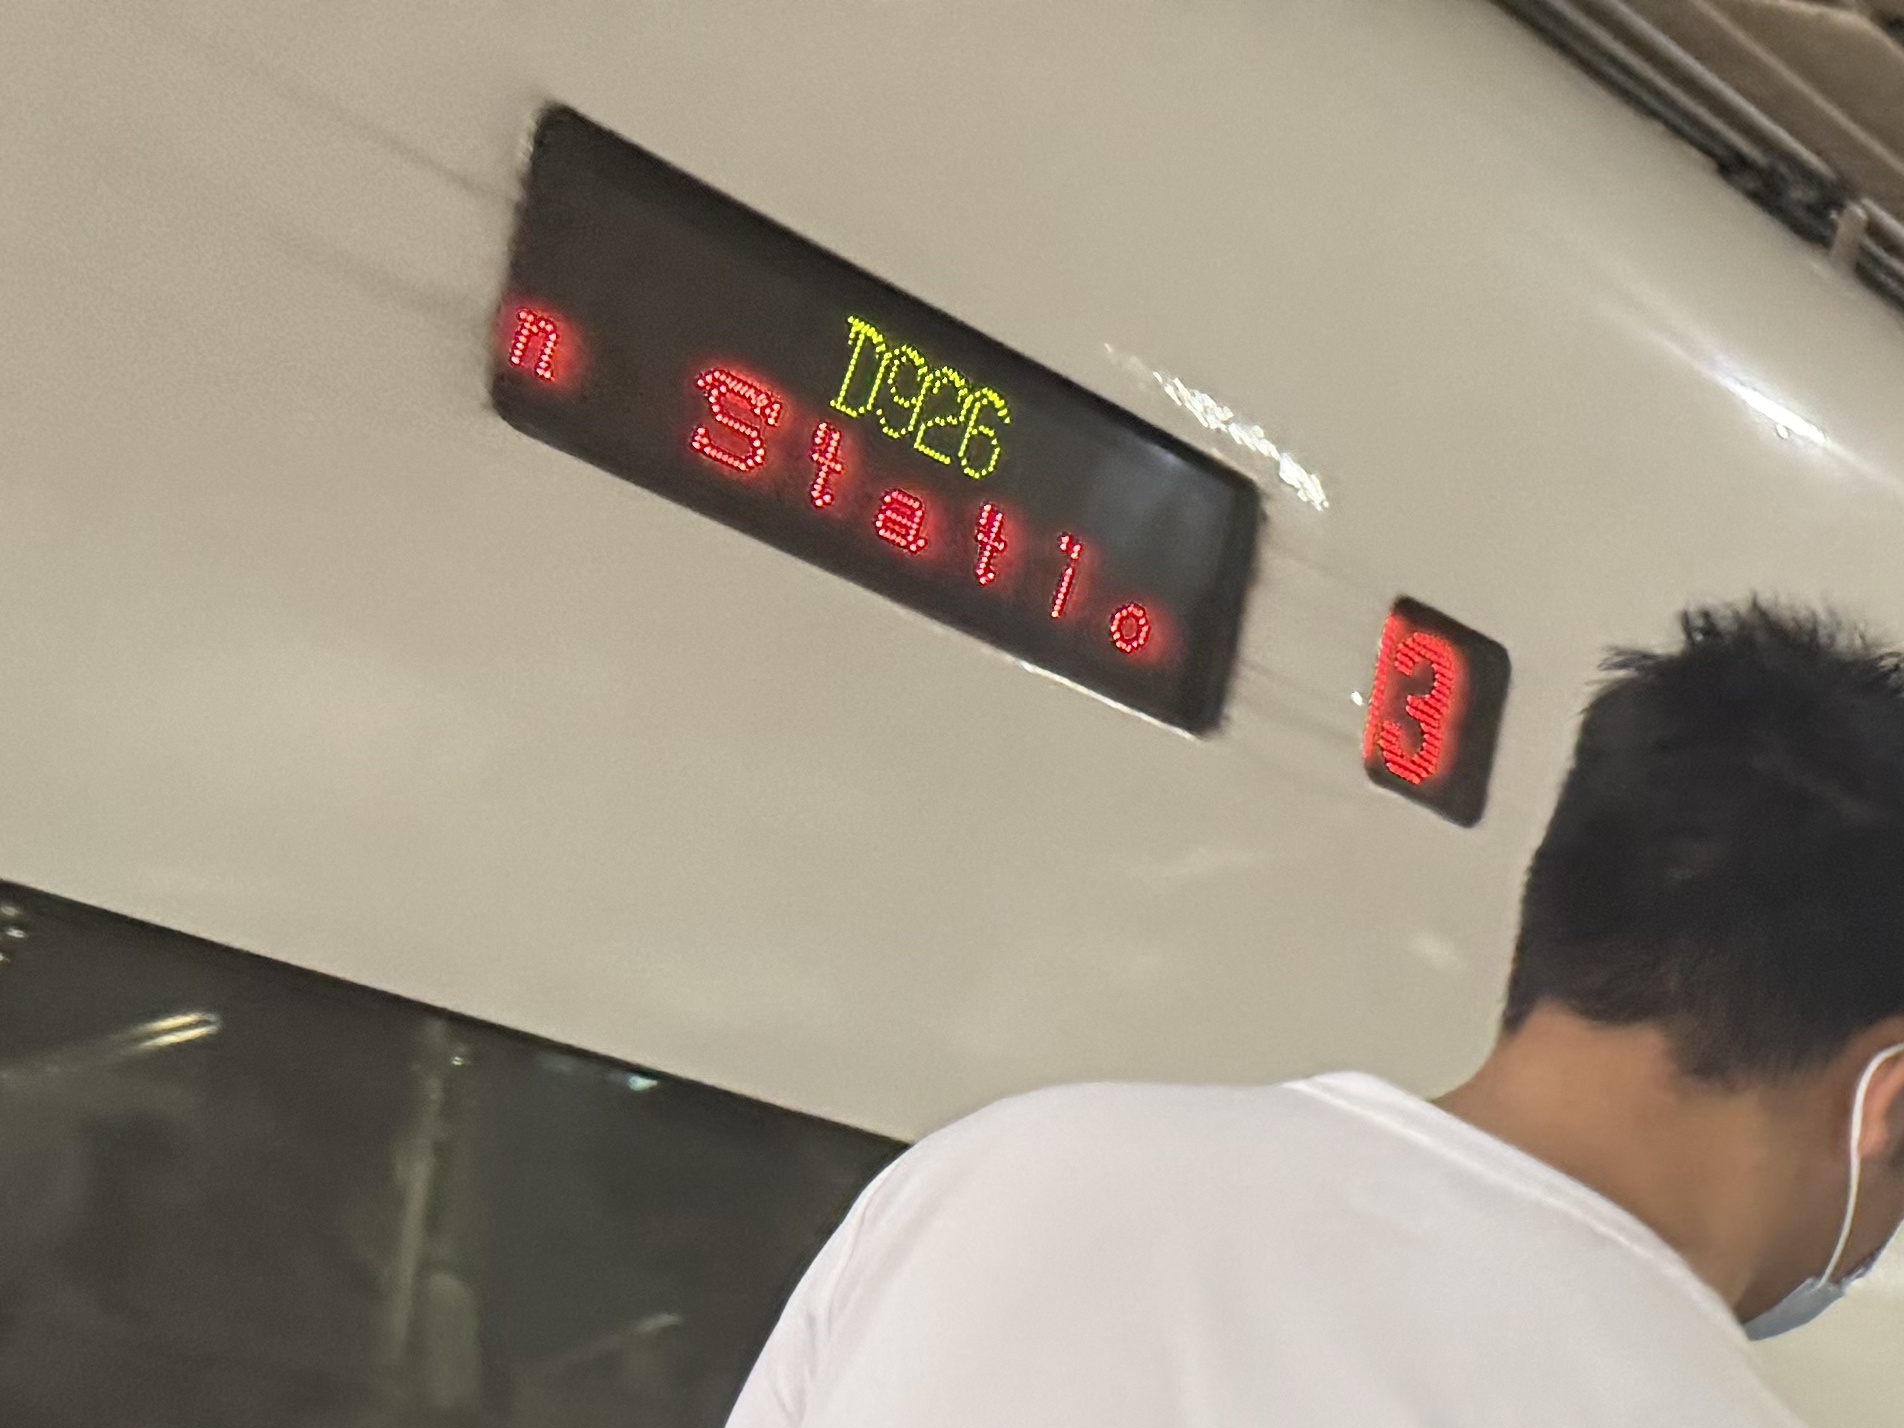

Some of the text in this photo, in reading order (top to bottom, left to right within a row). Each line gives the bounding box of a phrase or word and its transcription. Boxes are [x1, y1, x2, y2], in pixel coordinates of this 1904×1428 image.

[507, 306, 1155, 655] n Statio
[829, 314, 1012, 481] D926
